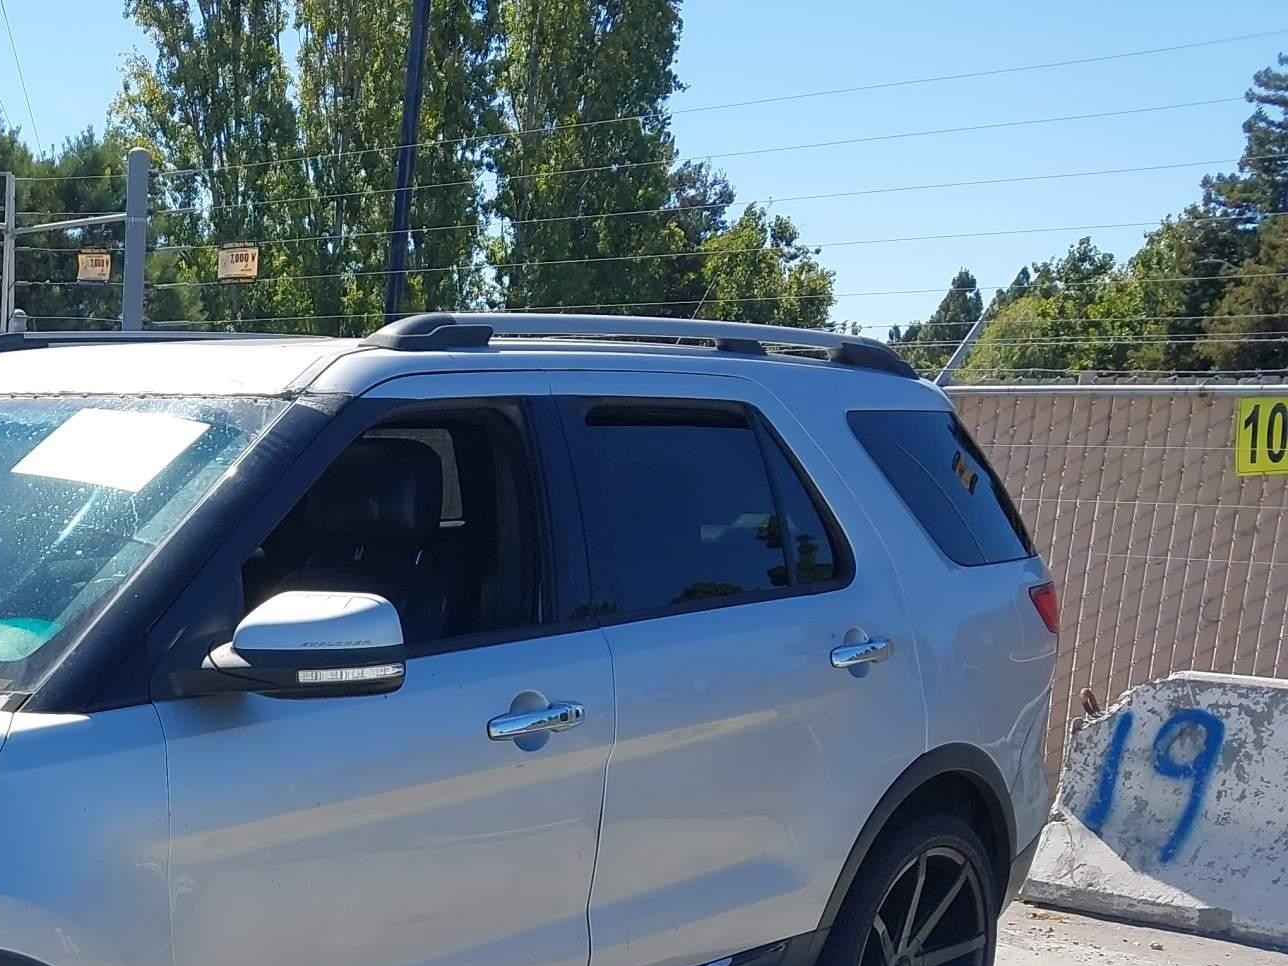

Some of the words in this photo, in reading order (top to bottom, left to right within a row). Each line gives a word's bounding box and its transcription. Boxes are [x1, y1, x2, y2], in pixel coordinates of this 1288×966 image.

[230, 252, 249, 264] 7,000
[251, 252, 257, 263] V
[1244, 402, 1288, 464] 10
[1083, 708, 1225, 864] 19
